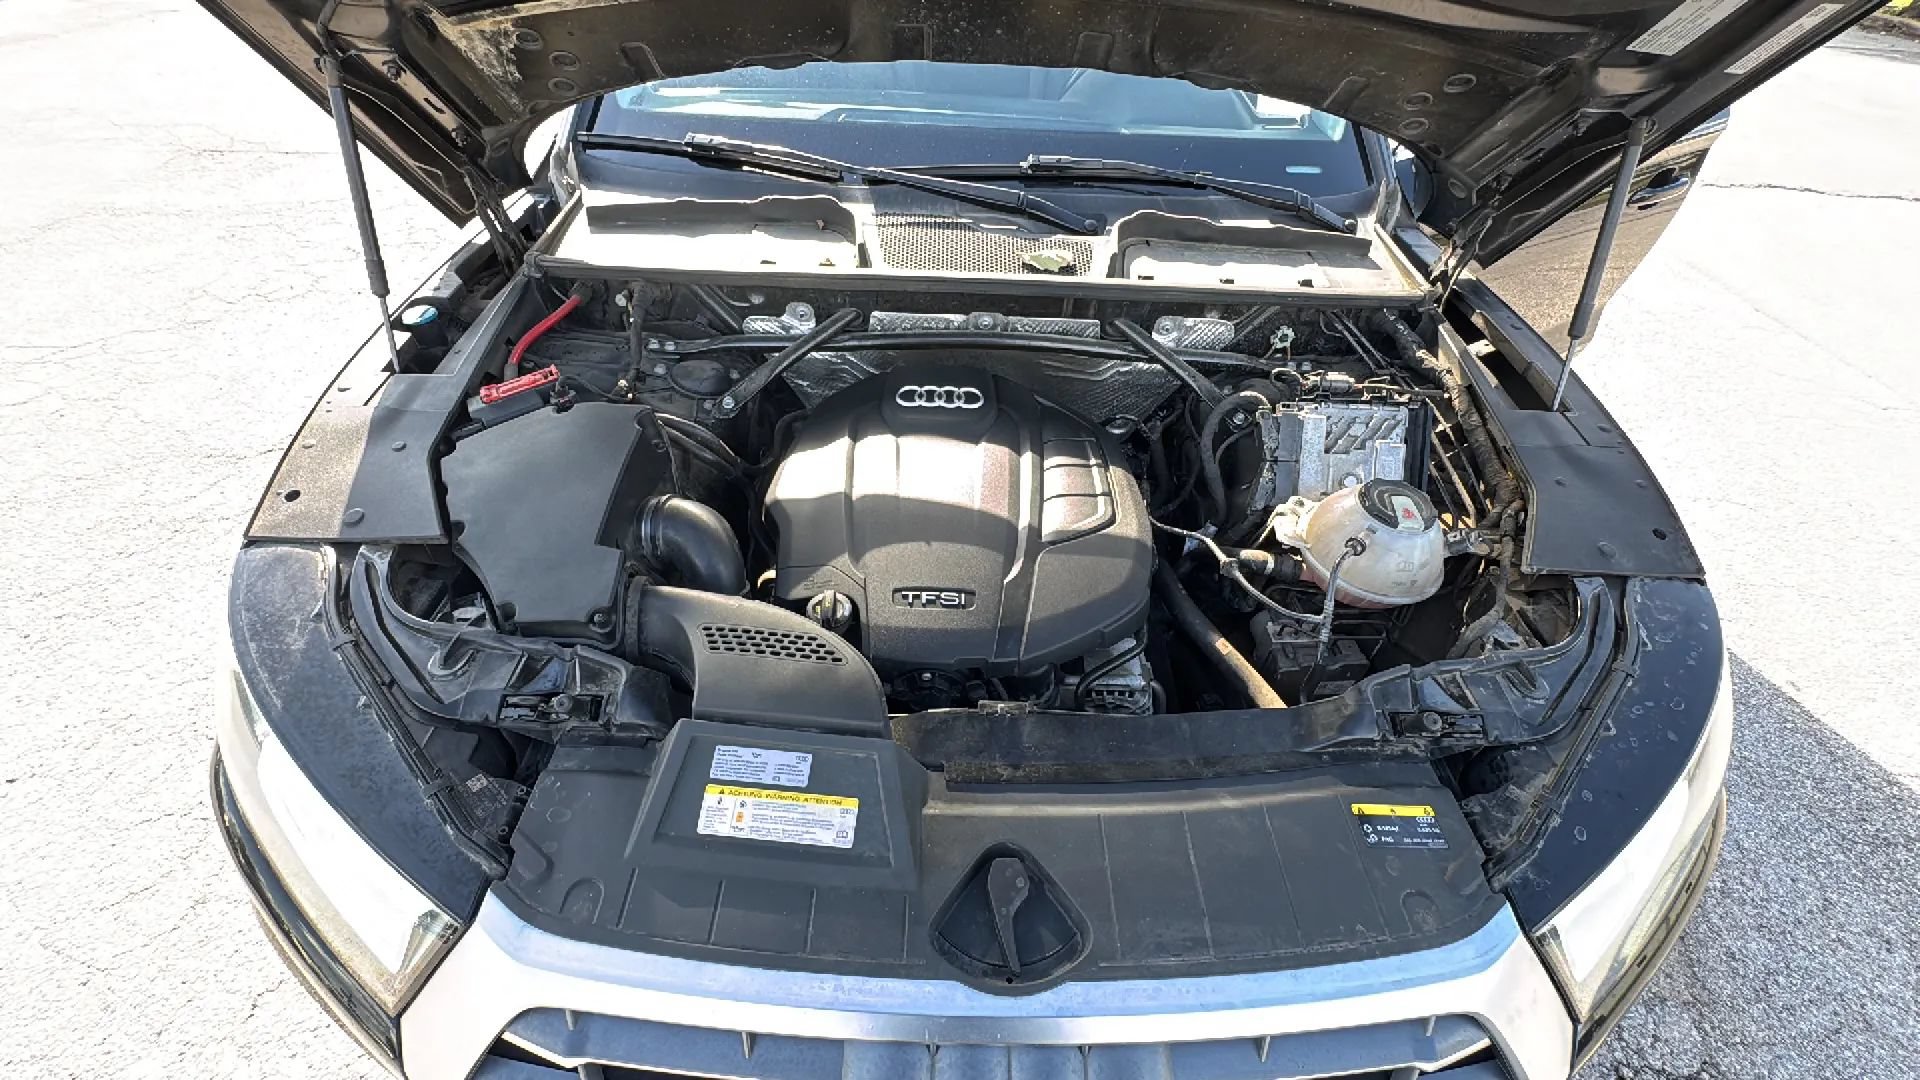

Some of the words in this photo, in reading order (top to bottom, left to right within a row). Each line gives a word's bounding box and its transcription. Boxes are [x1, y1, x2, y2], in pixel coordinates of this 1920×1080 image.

[901, 591, 965, 606] TFSI
[728, 789, 762, 799] ACHTUNG
[765, 793, 800, 802] WARNING
[803, 797, 842, 806] ATTENTION
